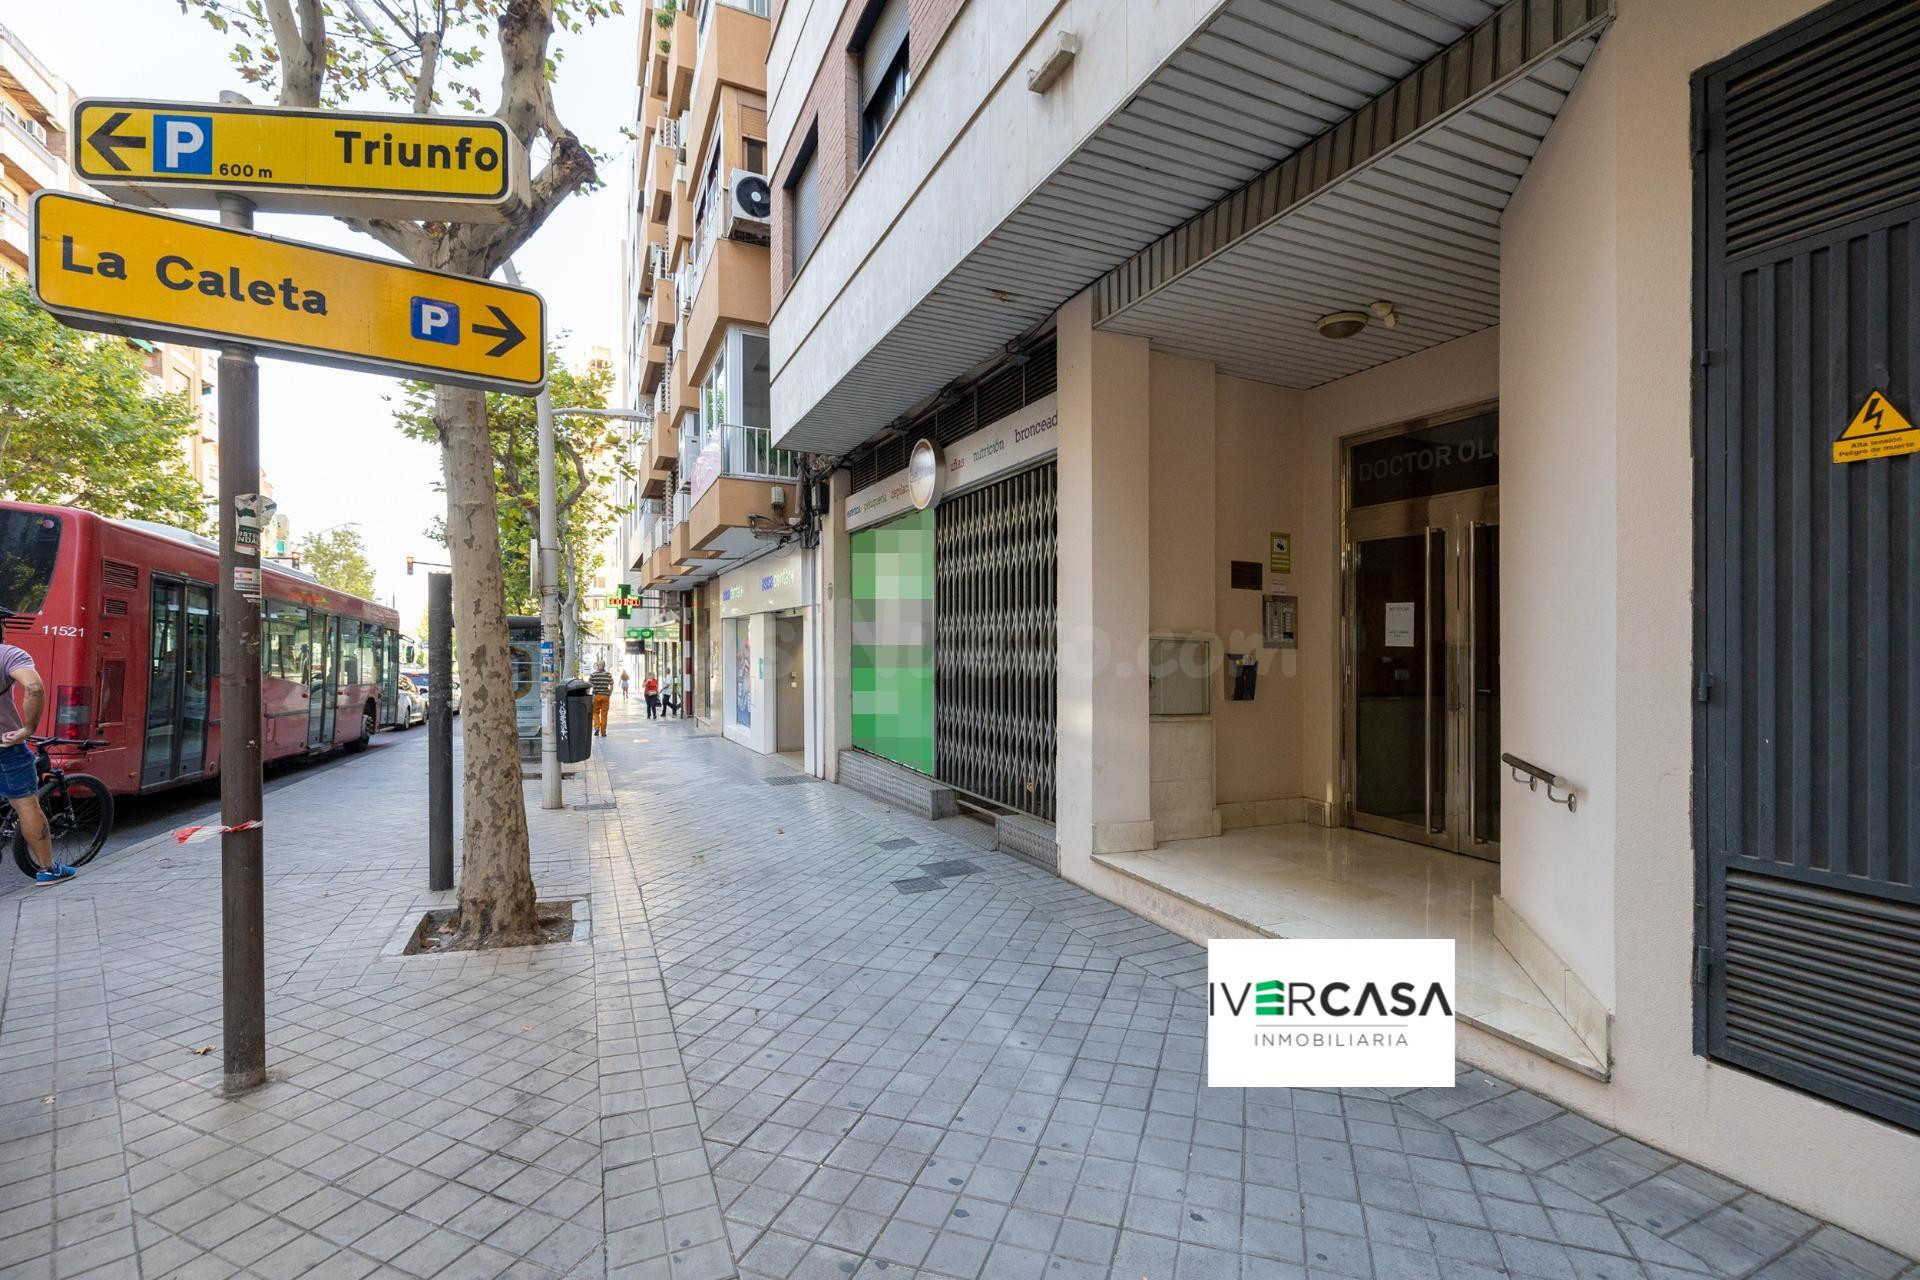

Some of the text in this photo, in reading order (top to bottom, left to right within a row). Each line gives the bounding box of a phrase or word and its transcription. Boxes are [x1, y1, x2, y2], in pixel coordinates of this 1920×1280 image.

[166, 121, 204, 168] P
[334, 130, 498, 171] Triunfo
[219, 163, 272, 178] 600 m
[62, 234, 328, 316] La Caleta
[422, 304, 449, 335] P
[972, 438, 1005, 462] nutrición
[1838, 449, 1868, 458] Peligro
[1883, 442, 1915, 451] muerte
[1870, 437, 1903, 446] tensión
[1359, 445, 1452, 482] DOCTOR
[42, 625, 84, 638] 11521
